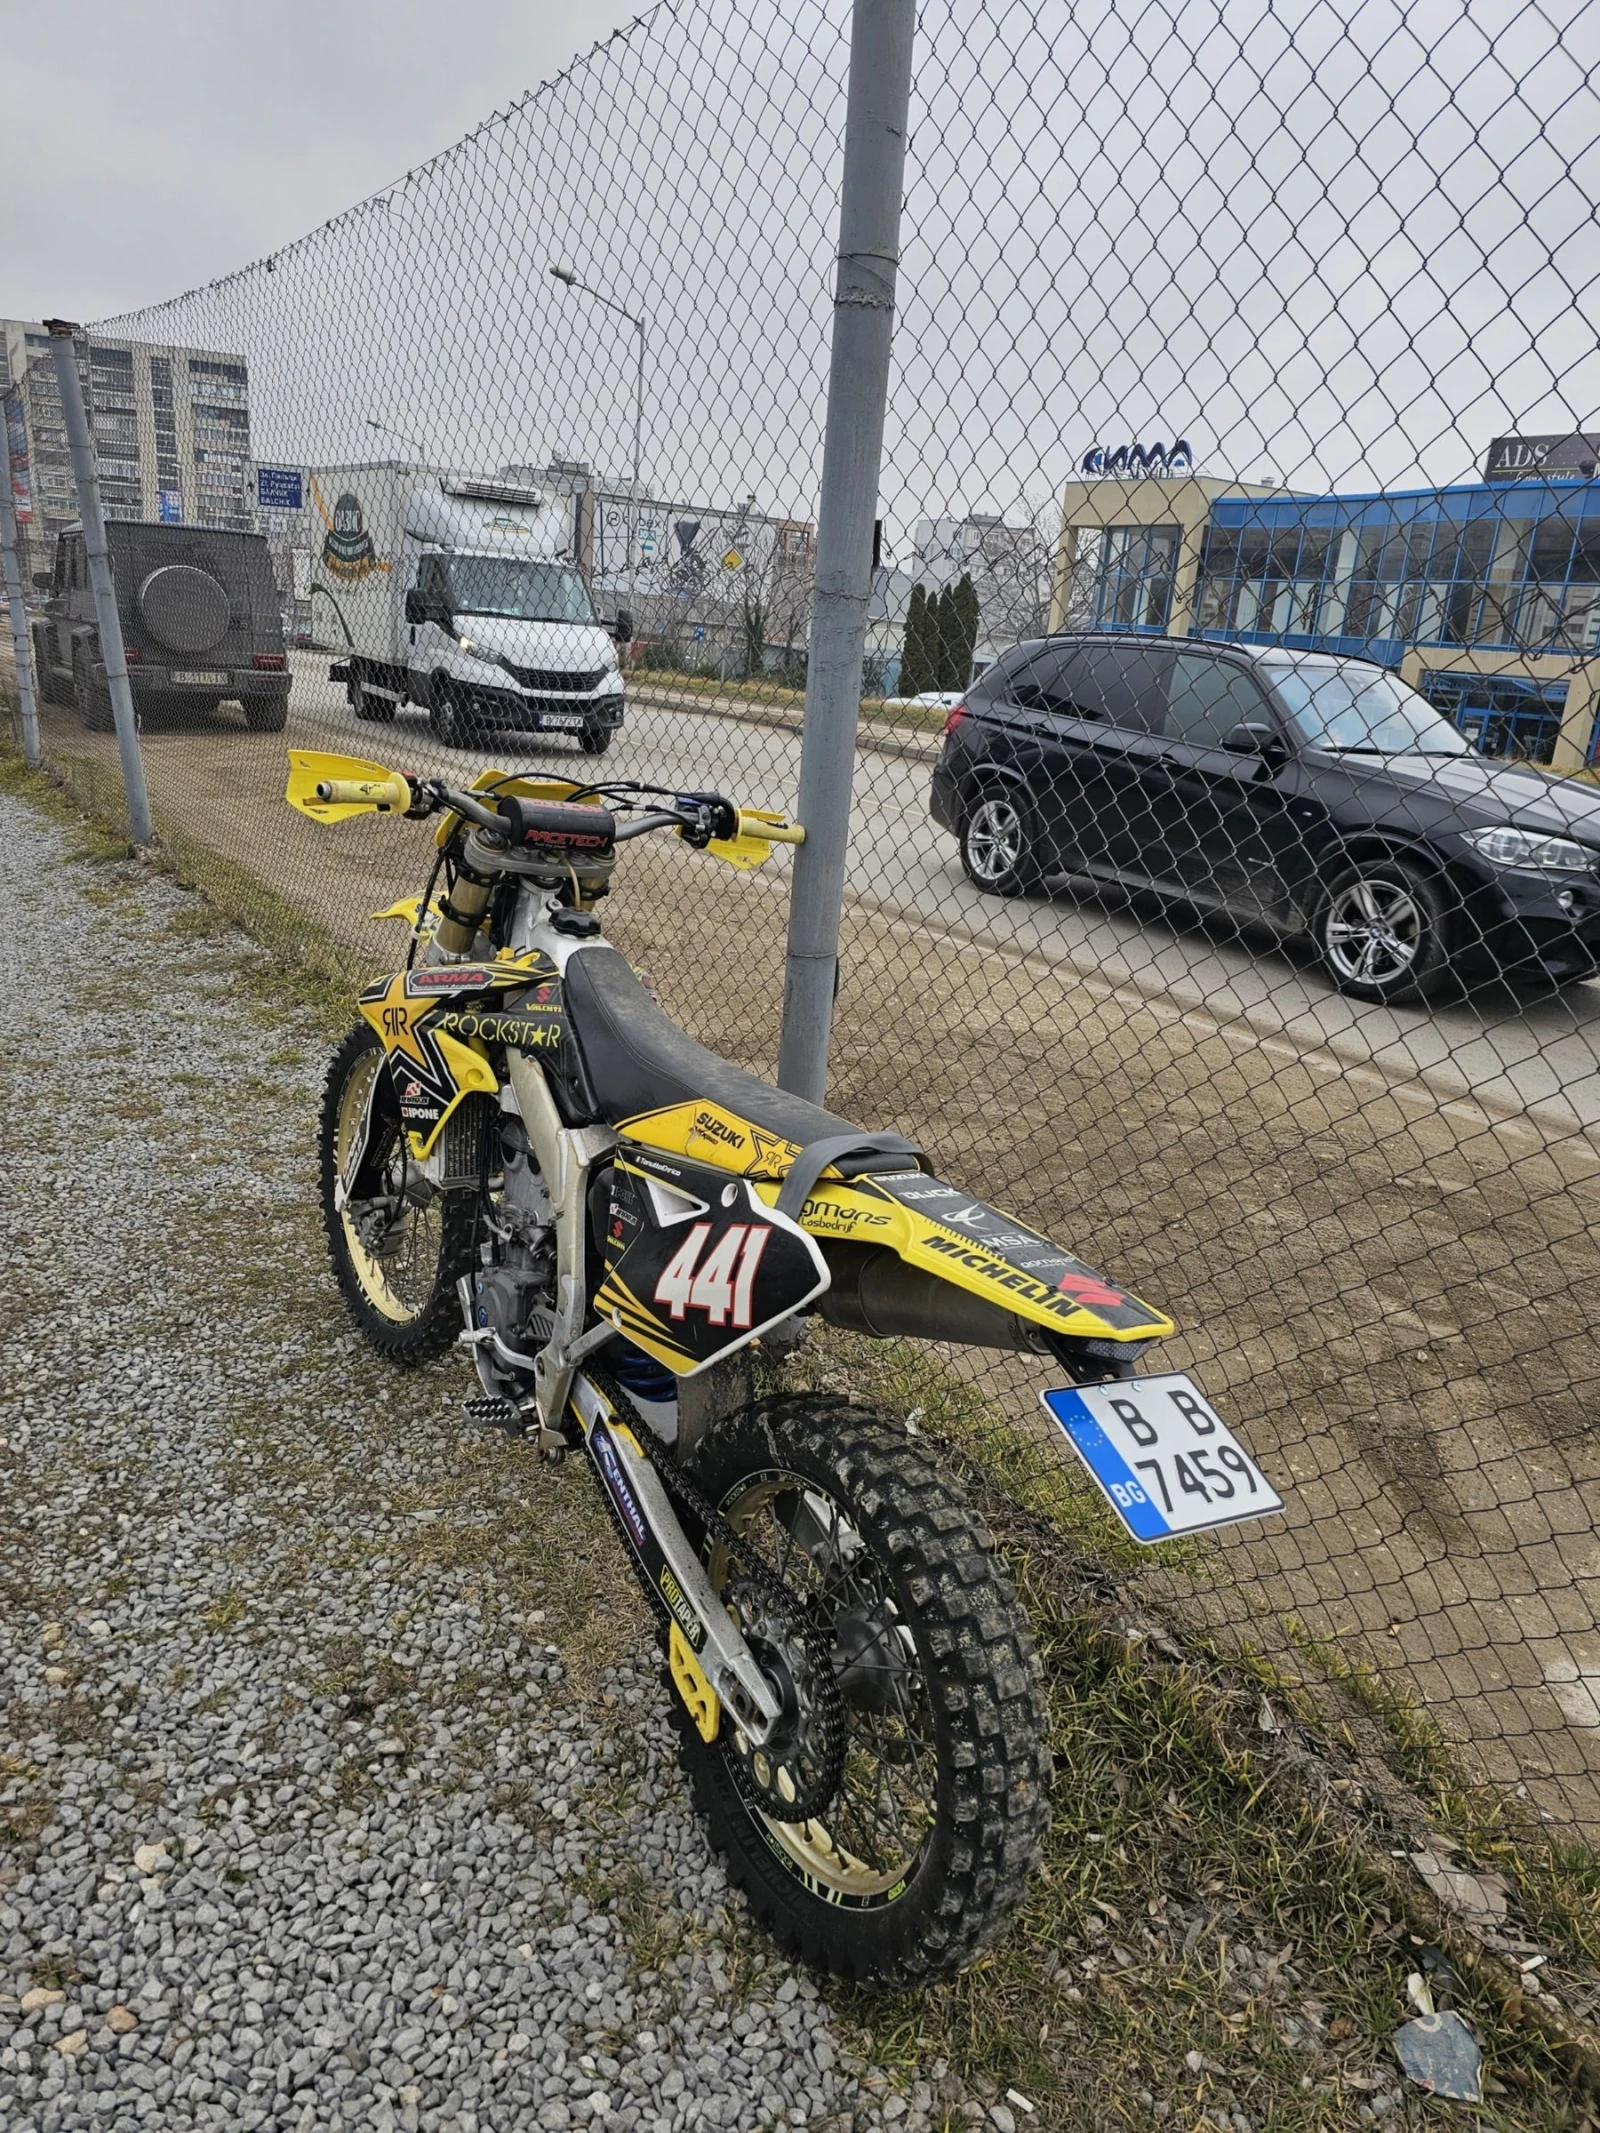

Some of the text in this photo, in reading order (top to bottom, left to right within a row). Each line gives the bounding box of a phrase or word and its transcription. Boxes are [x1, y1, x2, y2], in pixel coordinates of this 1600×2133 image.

[1494, 443, 1550, 468] ADS
[622, 509, 662, 530] cbex
[418, 971, 484, 985] ARMA
[408, 1107, 440, 1120] IPONE
[696, 1112, 746, 1149] SUZUKI
[654, 1221, 774, 1330] 441
[920, 1235, 1083, 1318] MICHELIN
[1108, 1389, 1216, 1448] B B
[1109, 1480, 1147, 1508] BG
[1133, 1444, 1258, 1513] 7459
[661, 1571, 700, 1642] PROTAPER
